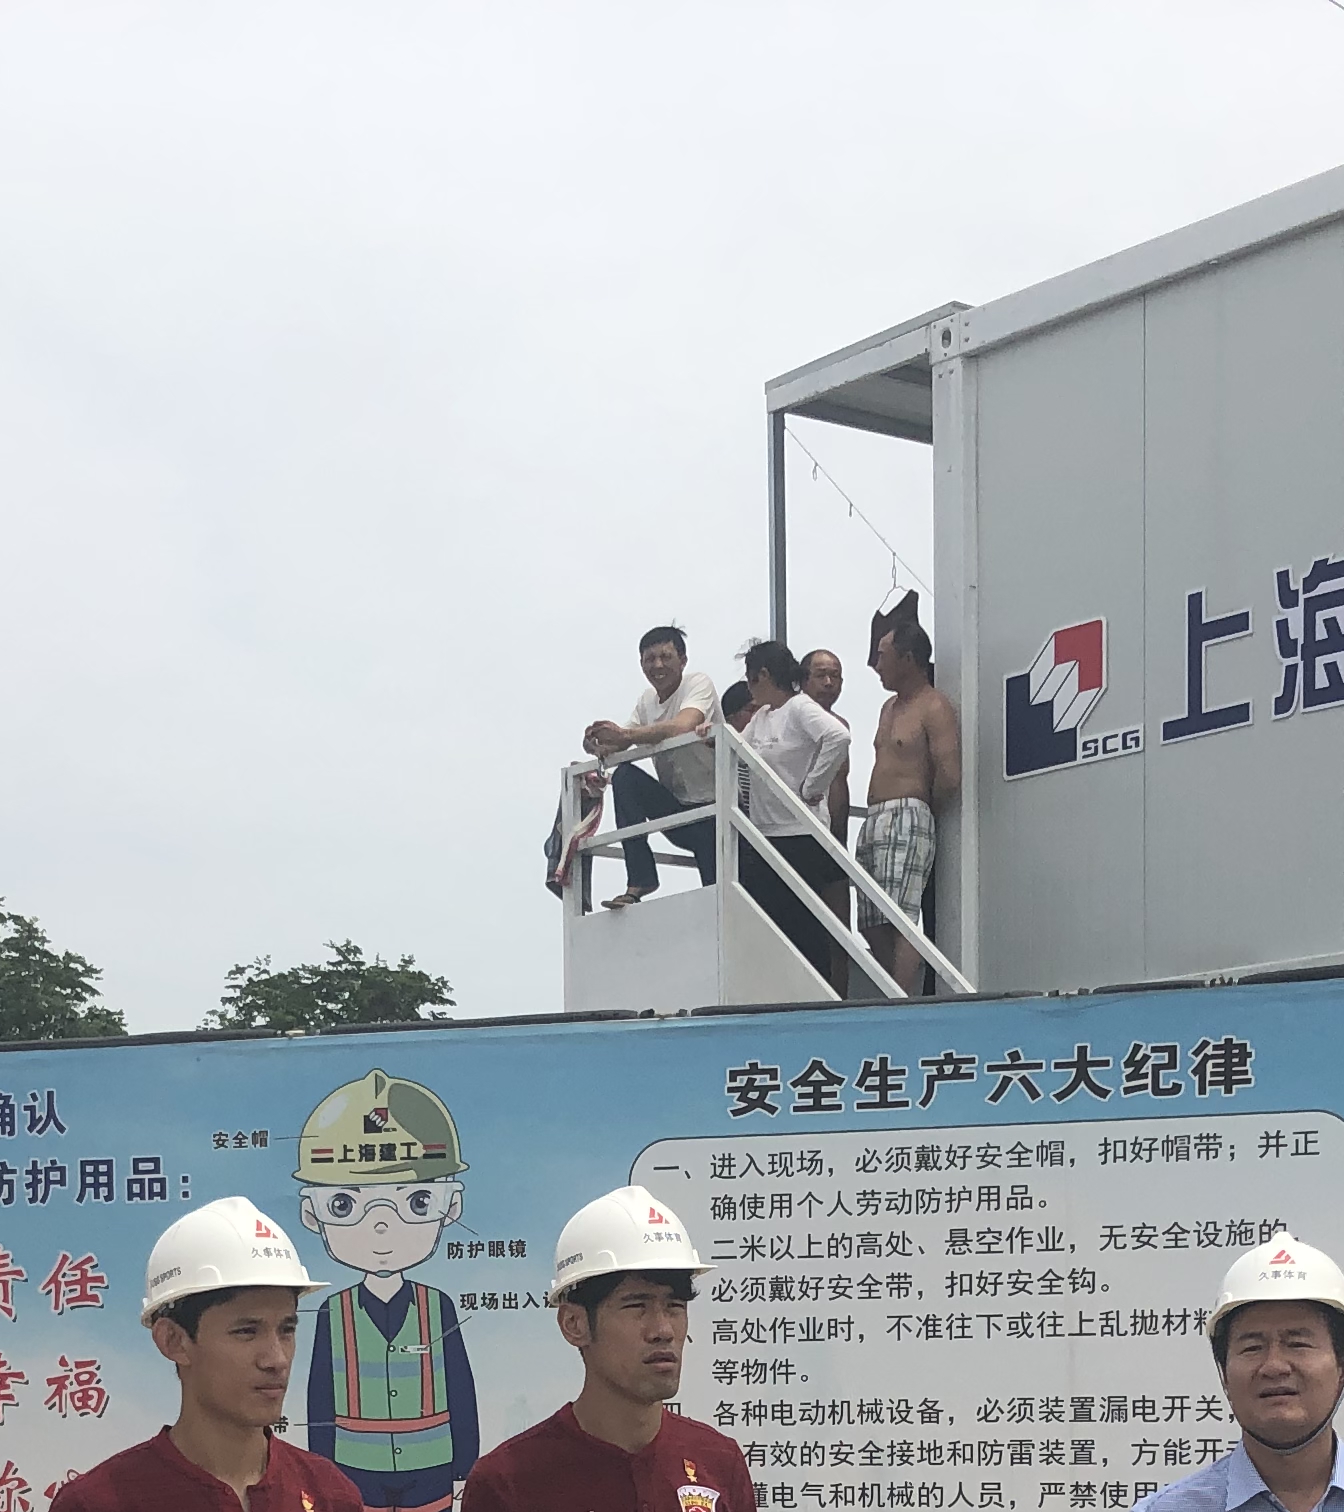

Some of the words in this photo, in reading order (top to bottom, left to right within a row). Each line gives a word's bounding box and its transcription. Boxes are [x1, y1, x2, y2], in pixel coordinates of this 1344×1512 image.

[1081, 728, 1140, 759] SCG
[725, 1037, 1254, 1117] 安全生产六大纪律
[212, 1130, 269, 1149] 安全帽
[337, 1142, 419, 1163] 上海建工
[653, 1130, 1321, 1180] 一、进入现场，必须戴好安全帽，扣好帽带；并正
[709, 1184, 1049, 1222] 确使用个人劳动防护用品。
[251, 1246, 292, 1260] 久事体育
[447, 1240, 527, 1260] 防护眼镜
[710, 1267, 1111, 1303] 必须戴好安全带，扣好安全钩。
[1258, 1269, 1308, 1282] 久事体育
[711, 1357, 811, 1386] 等物件。
[752, 1481, 1169, 1509] 懂电气和机械的人员，严禁使用
